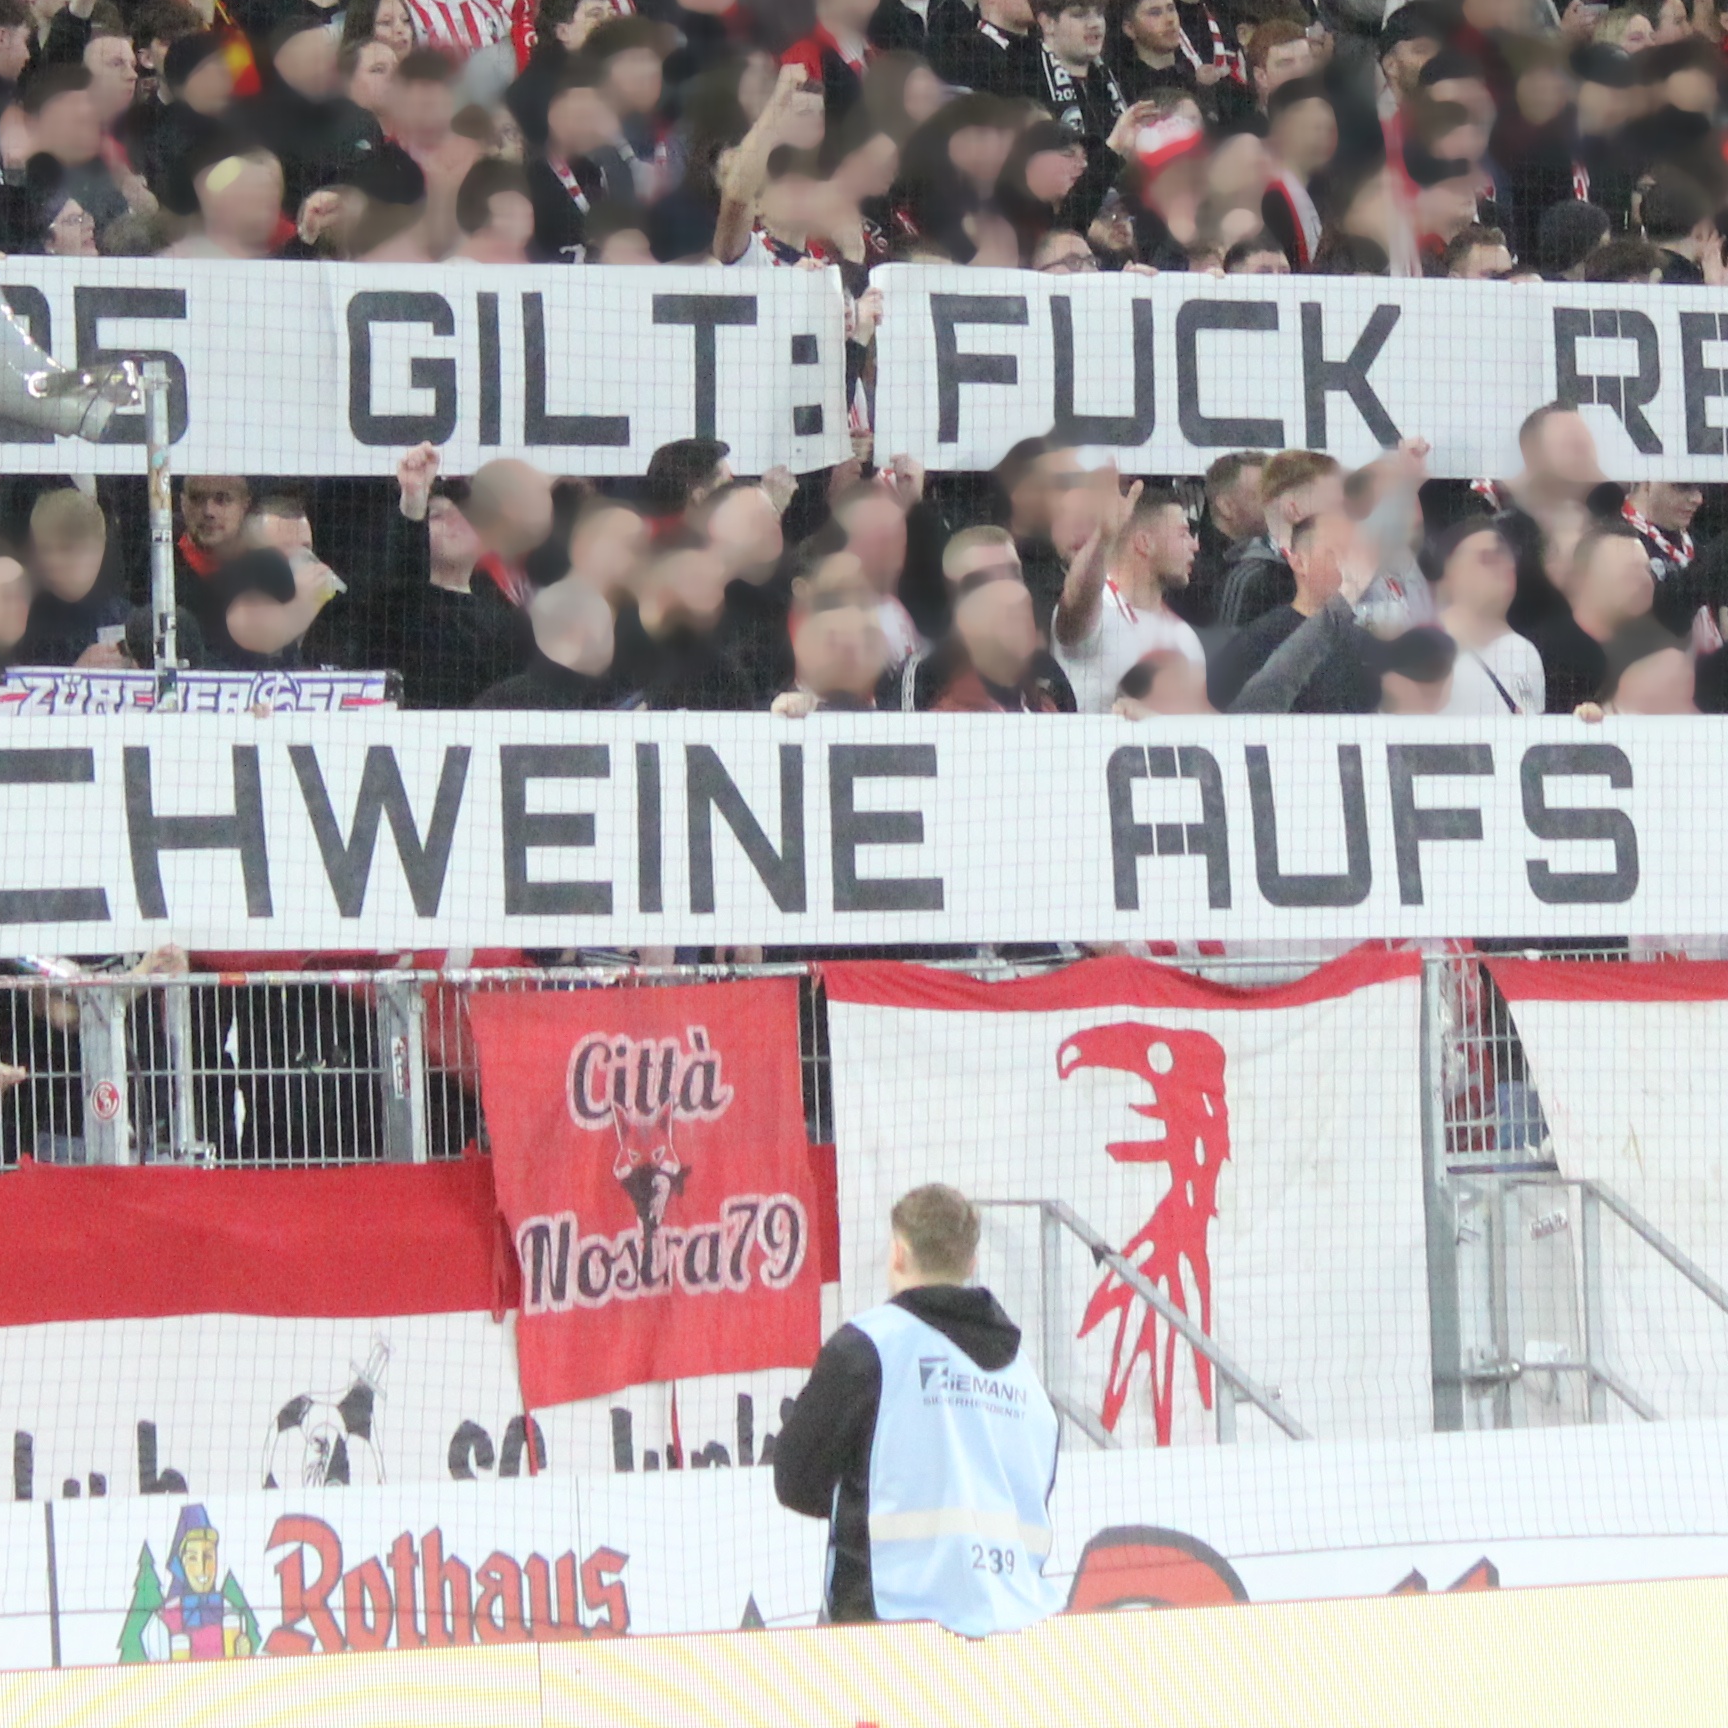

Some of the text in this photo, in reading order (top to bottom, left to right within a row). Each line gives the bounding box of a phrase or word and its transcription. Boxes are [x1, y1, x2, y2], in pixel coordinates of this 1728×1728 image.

[347, 290, 825, 448] GILT:
[930, 293, 1402, 451] FUCK
[1106, 744, 1640, 909] AUFS
[573, 1029, 727, 1125] Città
[262, 1513, 630, 1657] Rothaus
[972, 1543, 1016, 1575] 239
